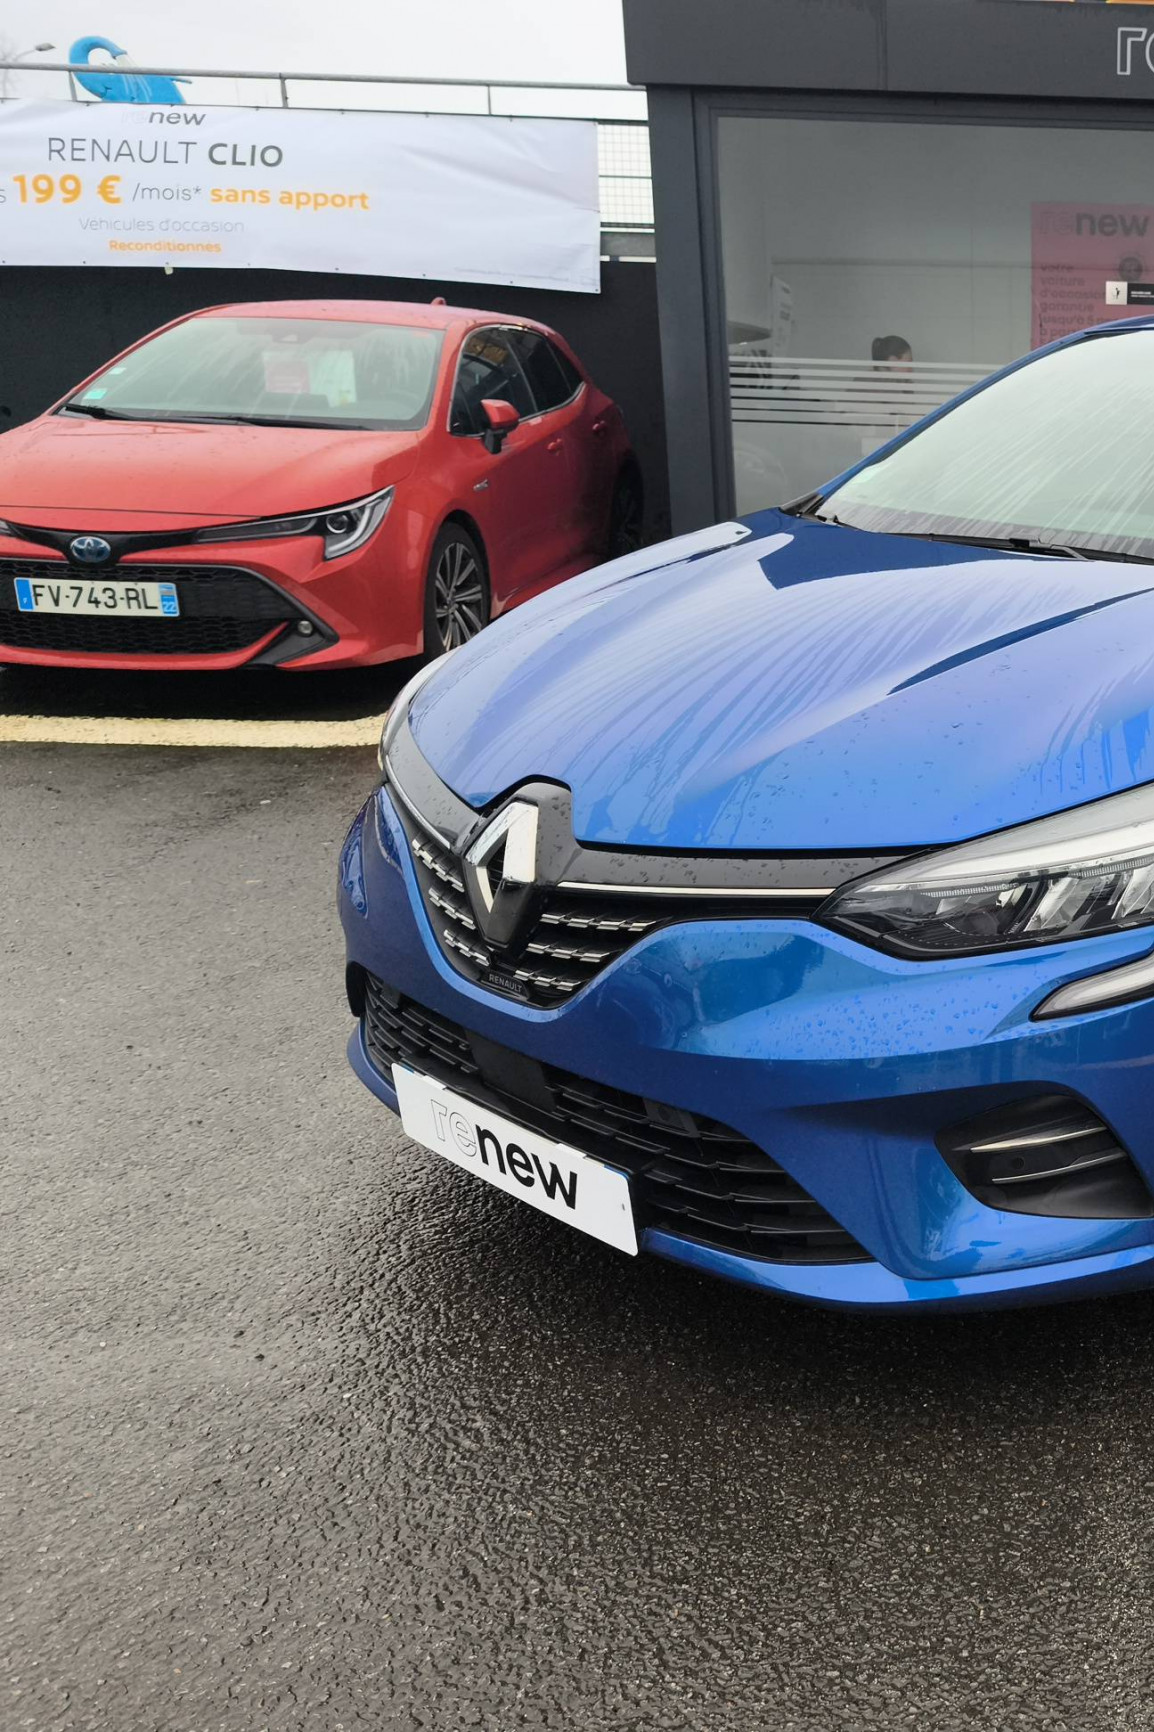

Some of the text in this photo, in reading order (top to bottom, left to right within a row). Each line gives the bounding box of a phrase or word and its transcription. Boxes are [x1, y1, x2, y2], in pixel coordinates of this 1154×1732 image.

[48, 137, 283, 168] RENAULT CLIO
[13, 173, 82, 204] 199
[97, 174, 122, 204] €
[210, 186, 270, 205] sans
[278, 190, 370, 211] apport
[158, 217, 245, 233] d'occasion
[32, 584, 158, 610] FV-743-RL
[489, 973, 522, 993] RENAULT
[430, 1098, 578, 1210] renew
